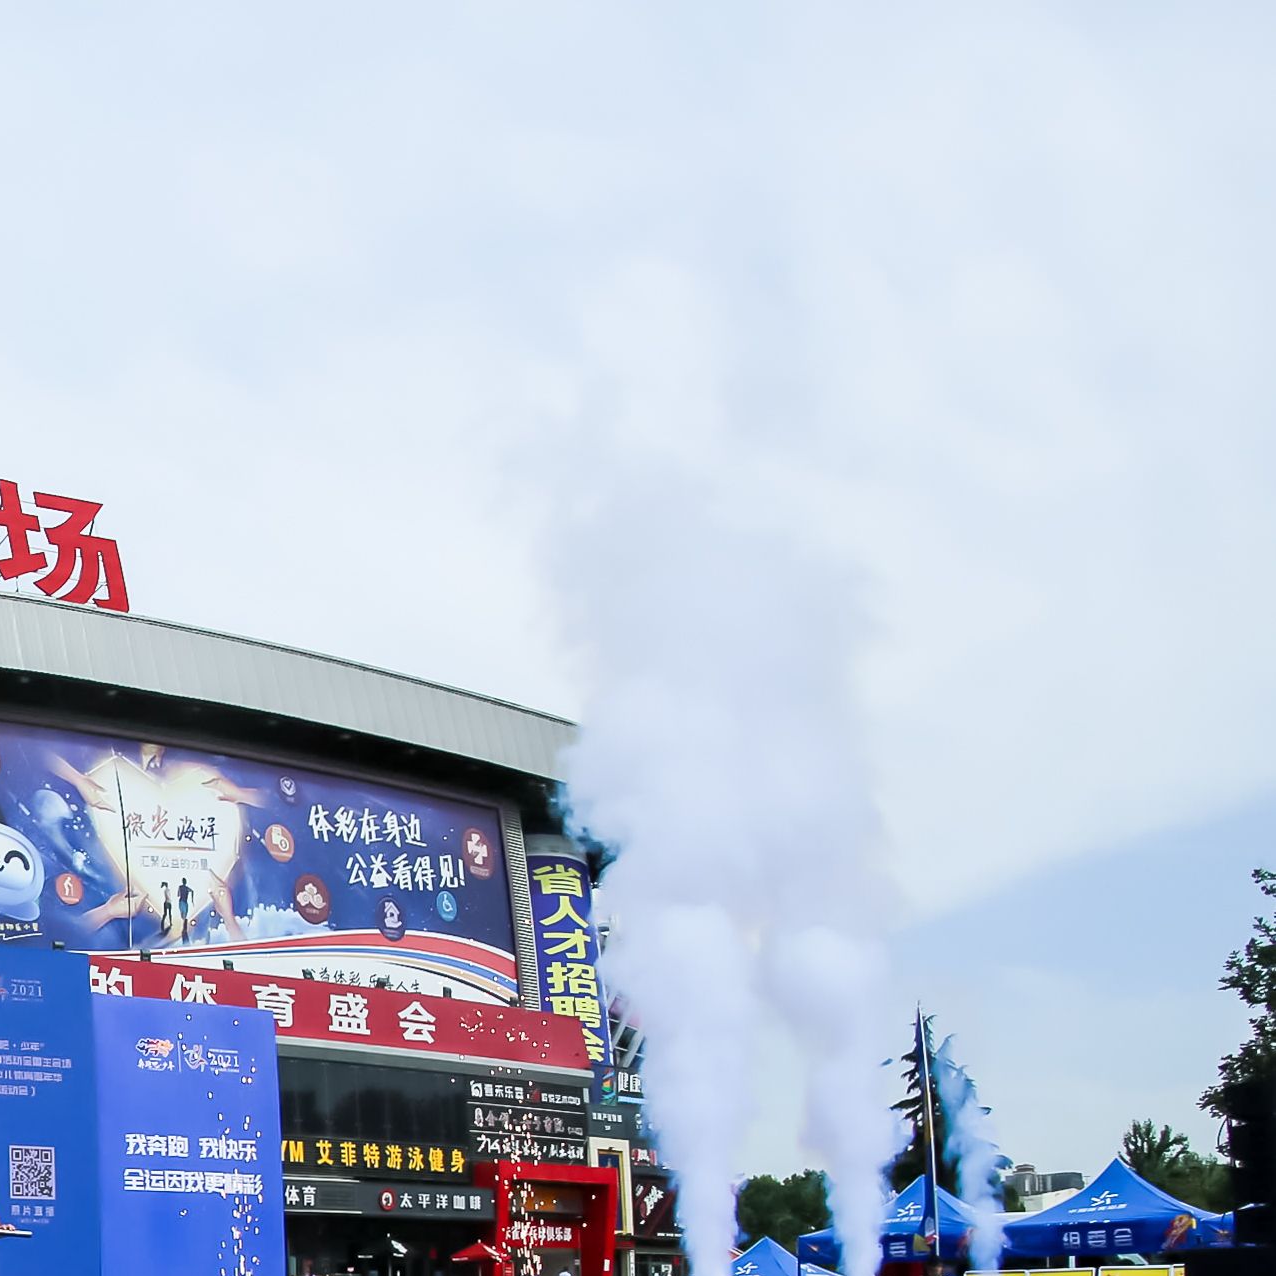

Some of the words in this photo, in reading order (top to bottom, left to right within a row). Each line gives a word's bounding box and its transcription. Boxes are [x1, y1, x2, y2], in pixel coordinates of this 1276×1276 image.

[125, 805, 220, 843] 微光海洋
[308, 804, 428, 847] 体彩在身边
[141, 855, 210, 871] 汇聚公益的力量
[346, 852, 466, 892] 公益看得见!
[11, 982, 43, 998] 2021
[90, 964, 438, 1045] 的体育盛会
[208, 1054, 240, 1068] 2021
[124, 1133, 189, 1158] 我奔跑
[198, 1137, 258, 1161] 我快乐
[316, 1138, 467, 1174] 艾菲特游泳健身
[123, 1168, 264, 1196] 全运因我更精彩
[284, 1183, 317, 1208] 体育
[10, 1204, 55, 1218] 照片直播
[399, 1192, 482, 1212] 太平洋咖啡
